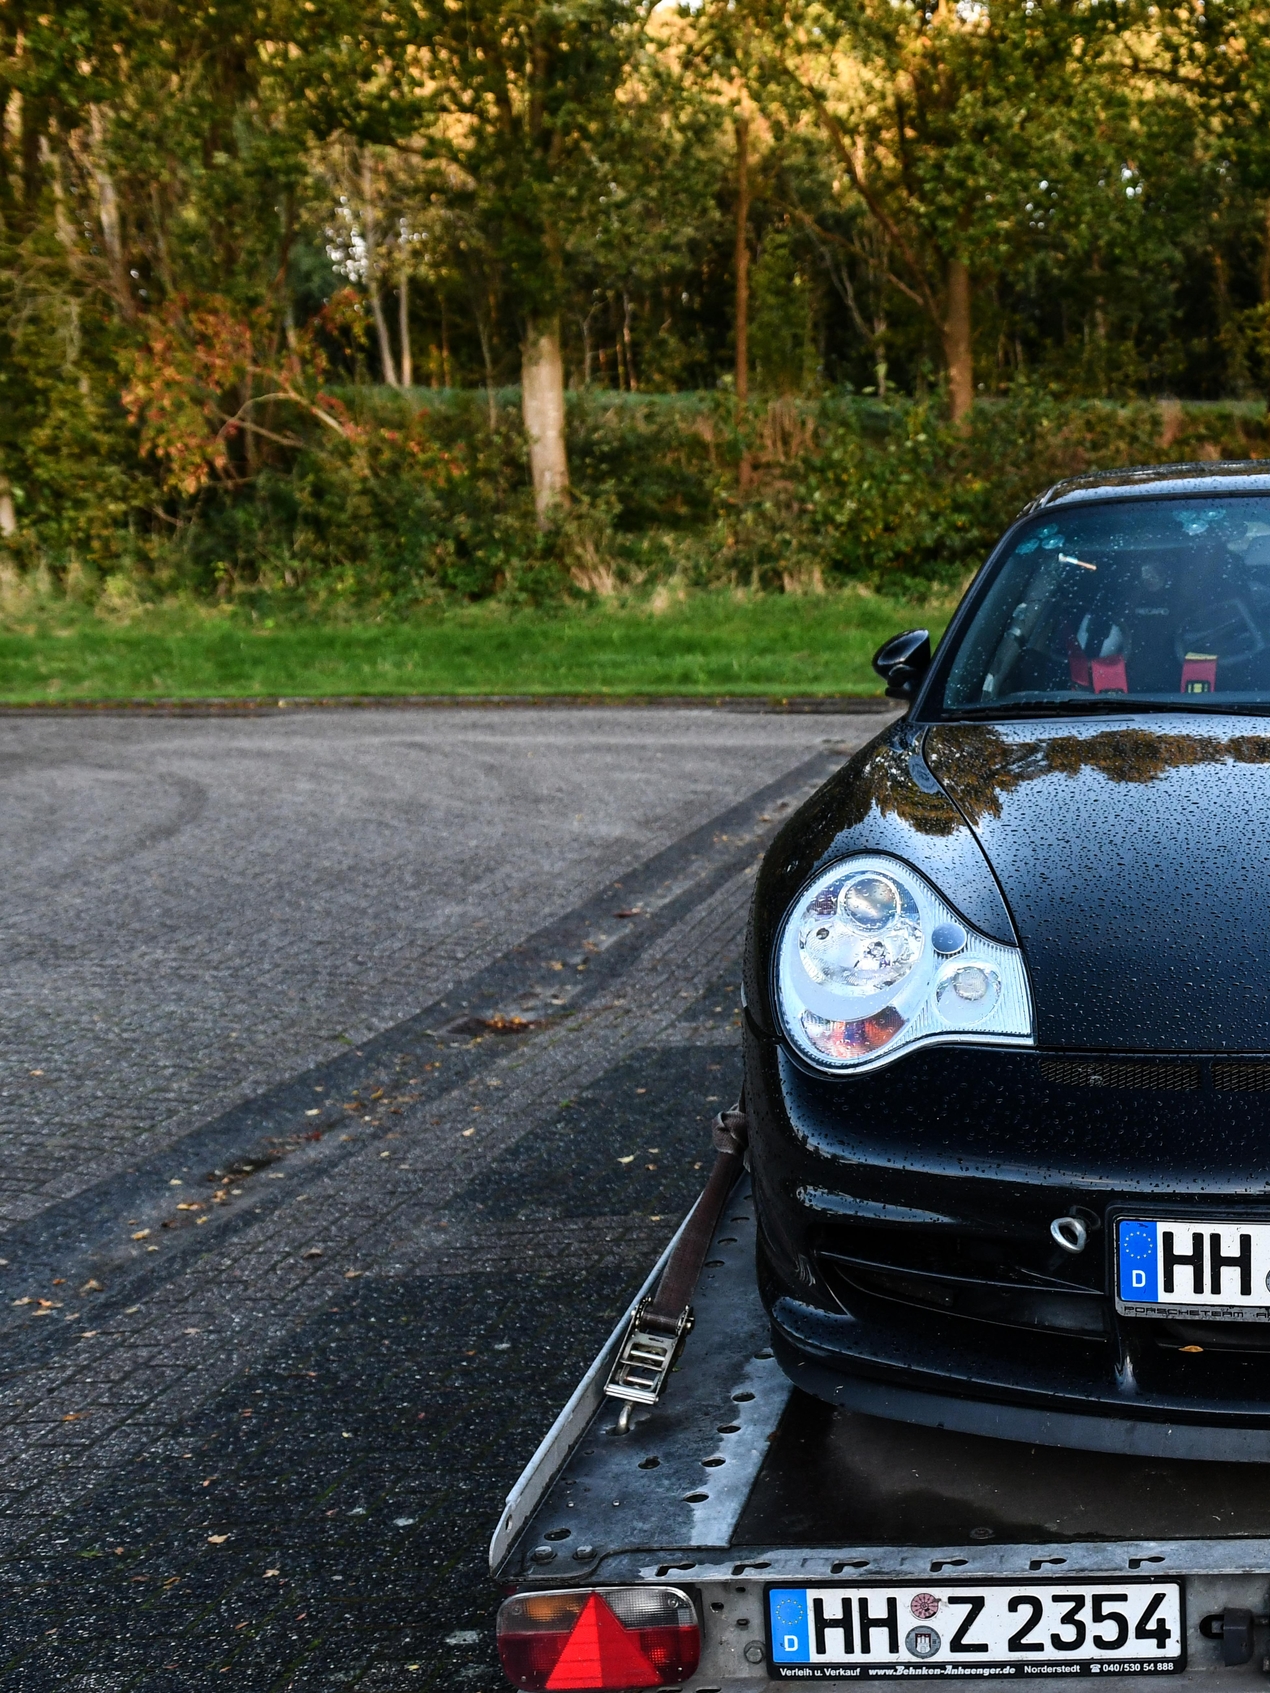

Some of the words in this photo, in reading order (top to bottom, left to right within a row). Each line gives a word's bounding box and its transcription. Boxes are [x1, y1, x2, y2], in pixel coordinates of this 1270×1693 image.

[1161, 1230, 1252, 1296] HH
[1131, 1269, 1146, 1288] D
[1123, 1305, 1244, 1318] PORSCHETEAM
[812, 1597, 899, 1655] HH
[947, 1595, 990, 1653] Z
[1007, 1592, 1172, 1653] 2354
[784, 1635, 799, 1652] D
[779, 1667, 812, 1677] Verleih
[814, 1669, 823, 1677] u.
[823, 1667, 861, 1677] Verkauf
[868, 1665, 1016, 1677] www.Behnken-Anhaenger.de
[1024, 1664, 1081, 1674] Norderstedt
[1102, 1662, 1141, 1673] 040/530
[1142, 1662, 1155, 1672] 54
[1156, 1662, 1174, 1671] 888
